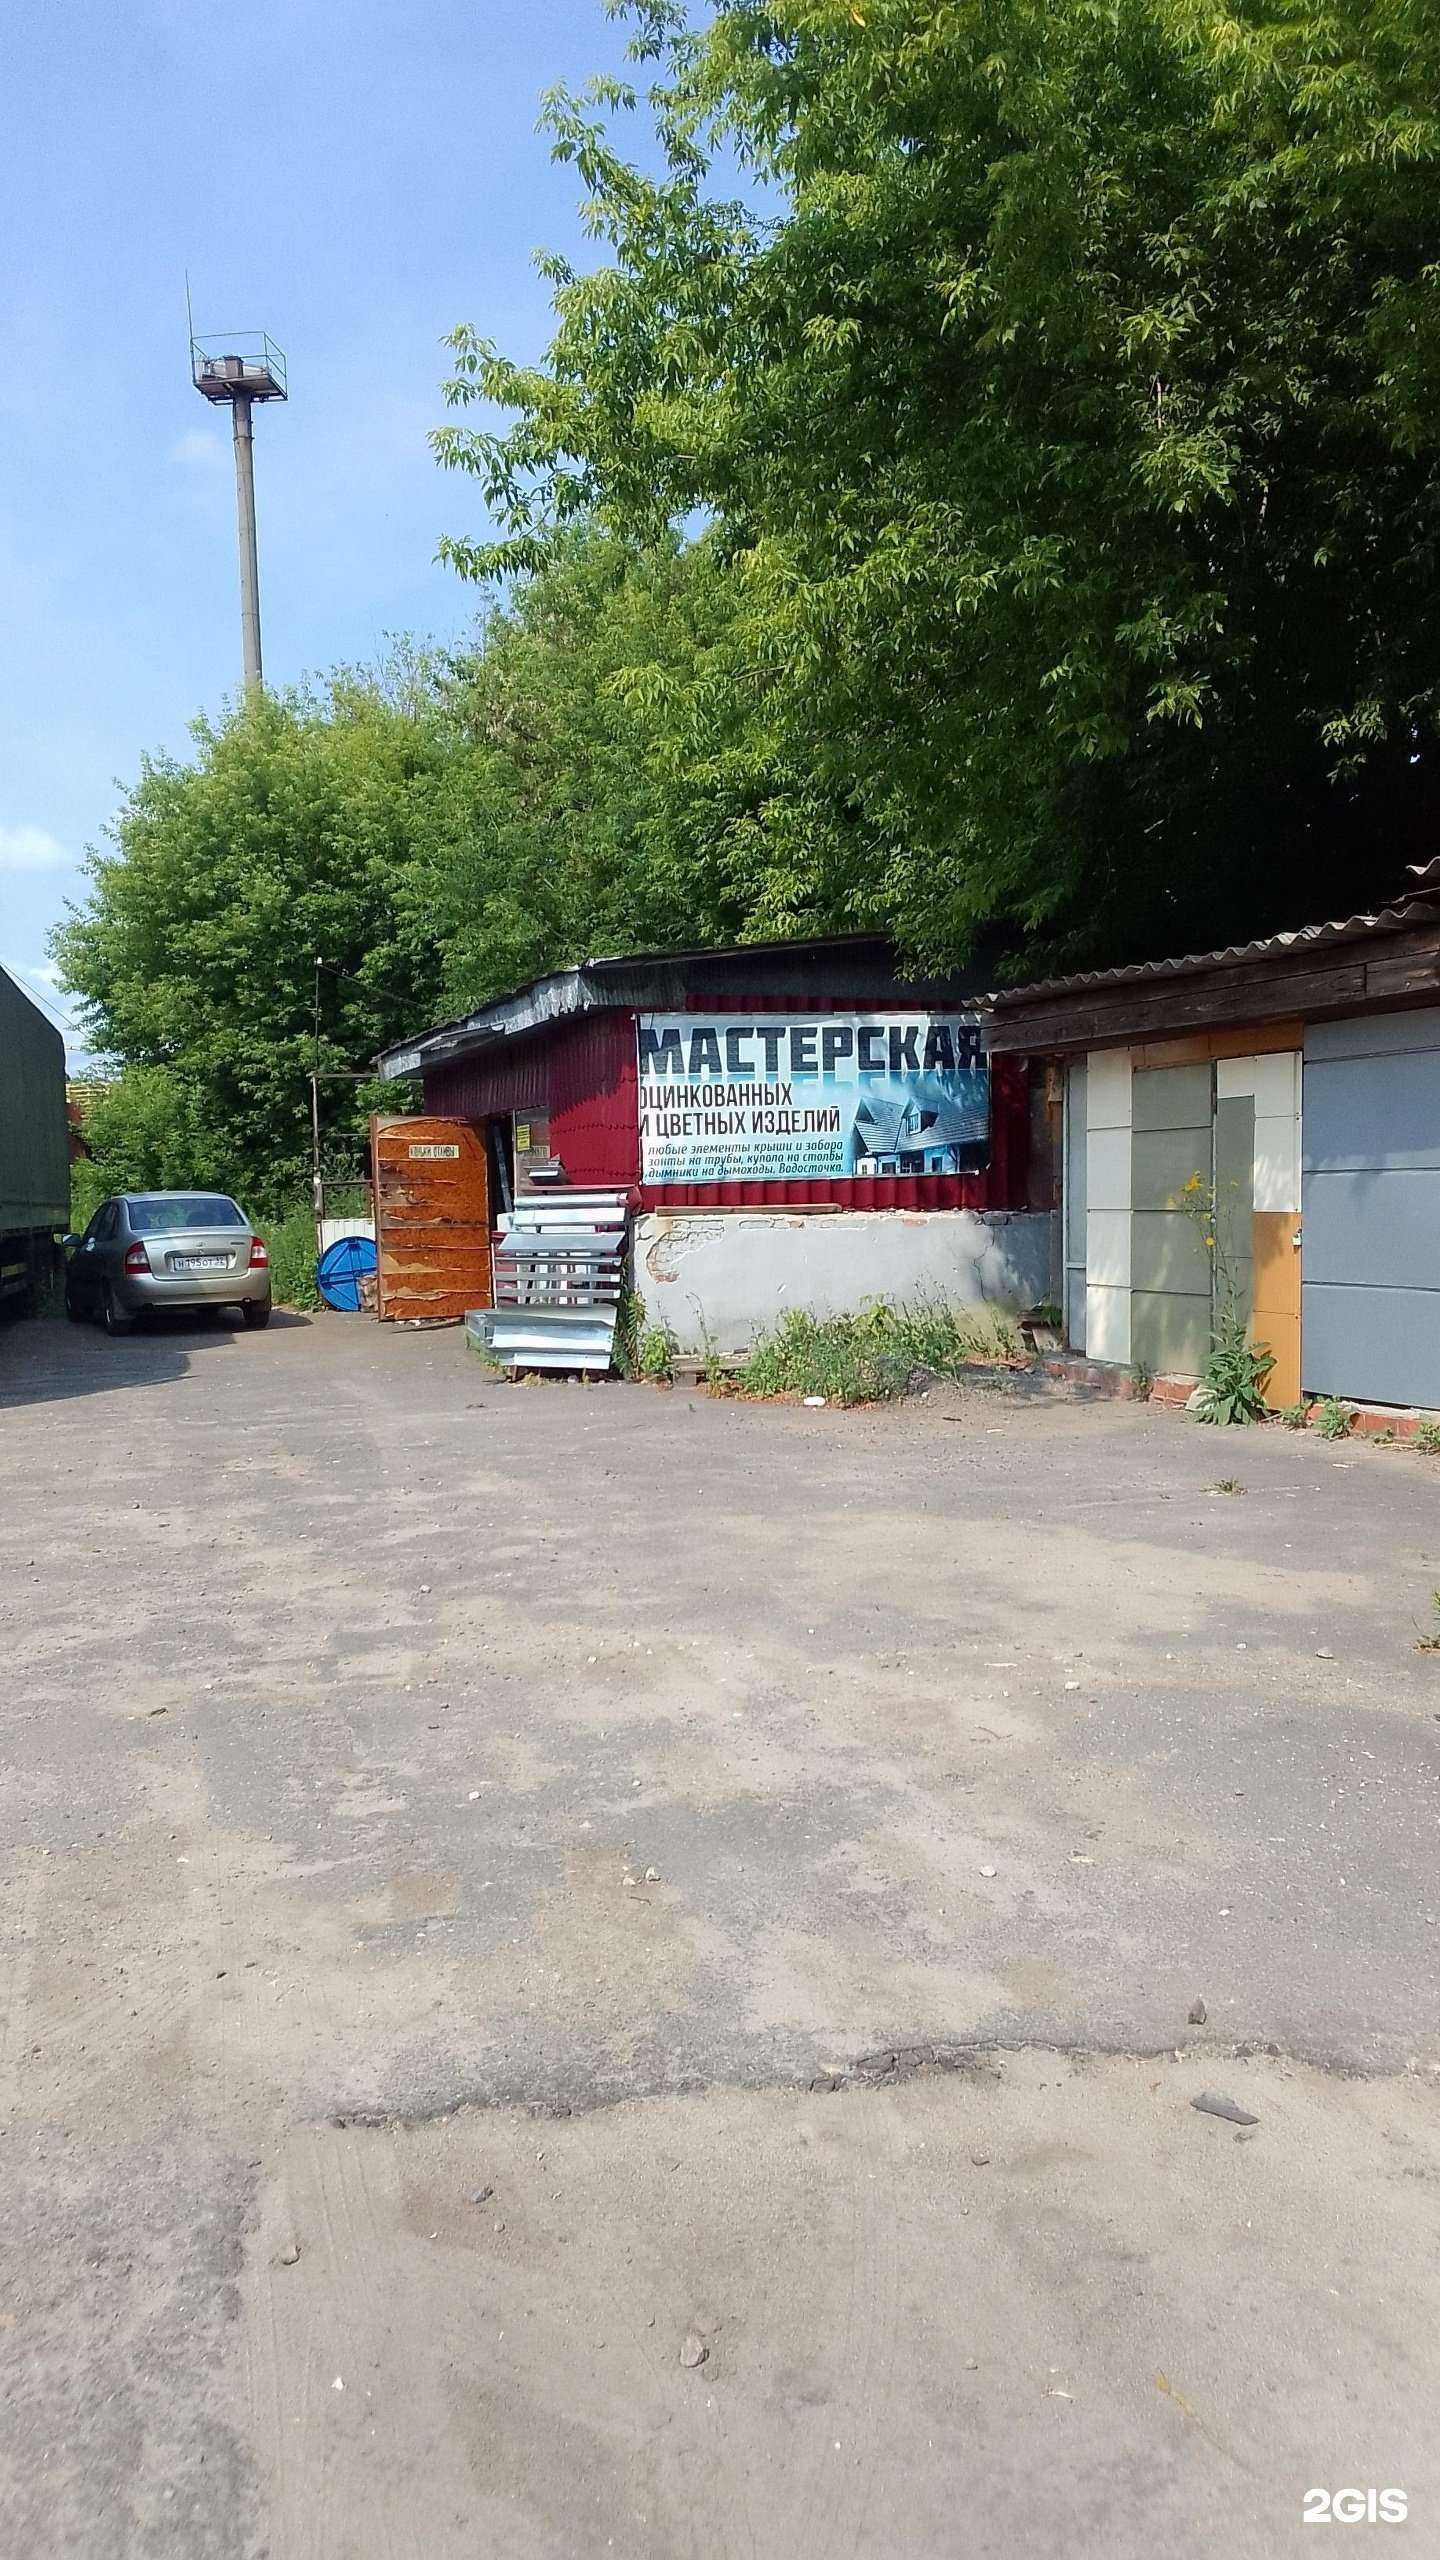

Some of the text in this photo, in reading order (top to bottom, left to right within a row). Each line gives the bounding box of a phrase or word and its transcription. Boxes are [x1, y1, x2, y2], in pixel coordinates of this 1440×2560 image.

[640, 1025, 988, 1074] МАСТЕРСКАЯ
[640, 1083, 793, 1109] ОЦИНКОВАННЫХ
[640, 1105, 841, 1138] И ЦВЕТНЫХ ИЗДЕЛИЙ
[648, 1143, 688, 1155] любые
[691, 1144, 750, 1154] элементы
[754, 1142, 793, 1154] крыши
[805, 1139, 843, 1153] забора
[648, 1152, 844, 1168] зонты на трубы, купола на столбы
[702, 1168, 714, 1176] на
